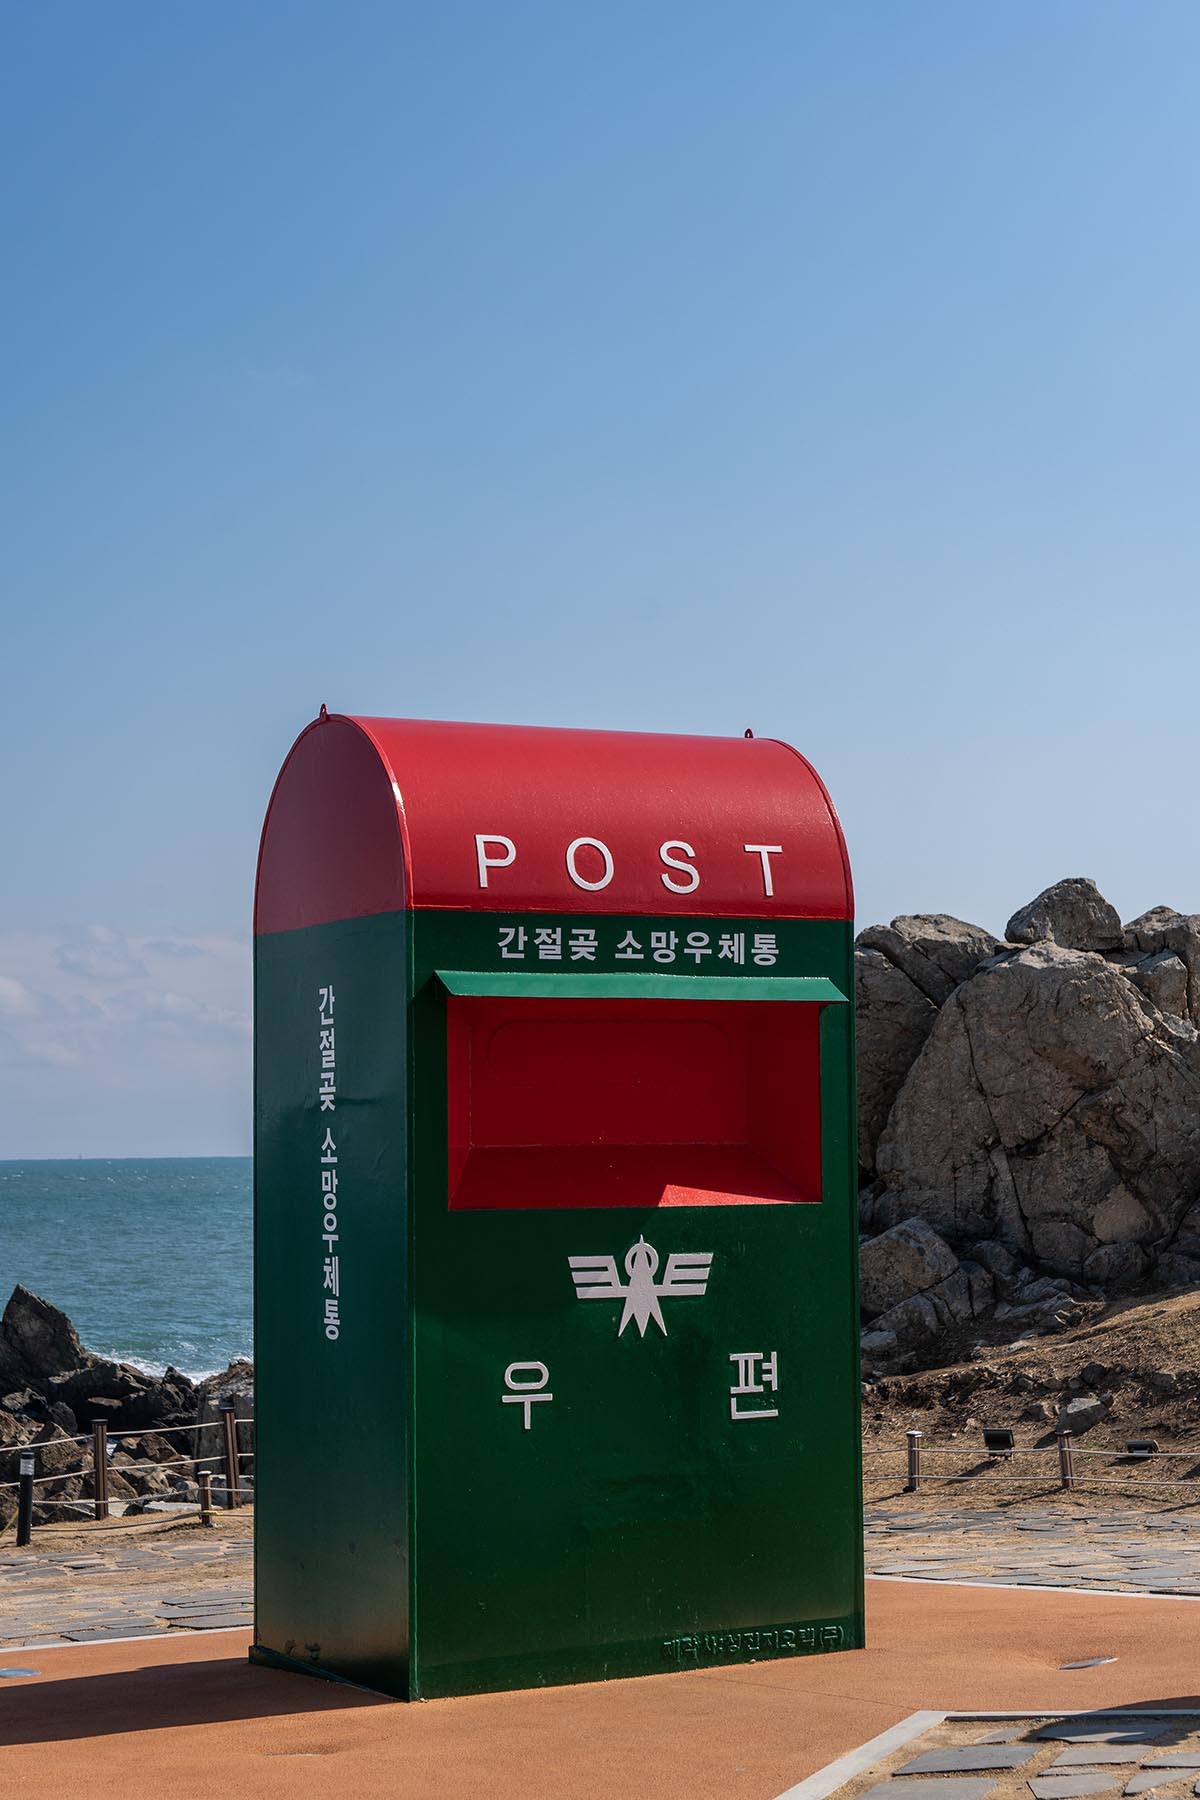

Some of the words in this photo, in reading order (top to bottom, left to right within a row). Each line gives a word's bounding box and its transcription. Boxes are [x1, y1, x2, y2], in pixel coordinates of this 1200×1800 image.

[476, 834, 783, 896] POST
[498, 927, 598, 960] 간절곶
[615, 931, 779, 965] 소망우체통
[319, 985, 336, 1111] 간절곶
[321, 1128, 340, 1340] 소망우체통
